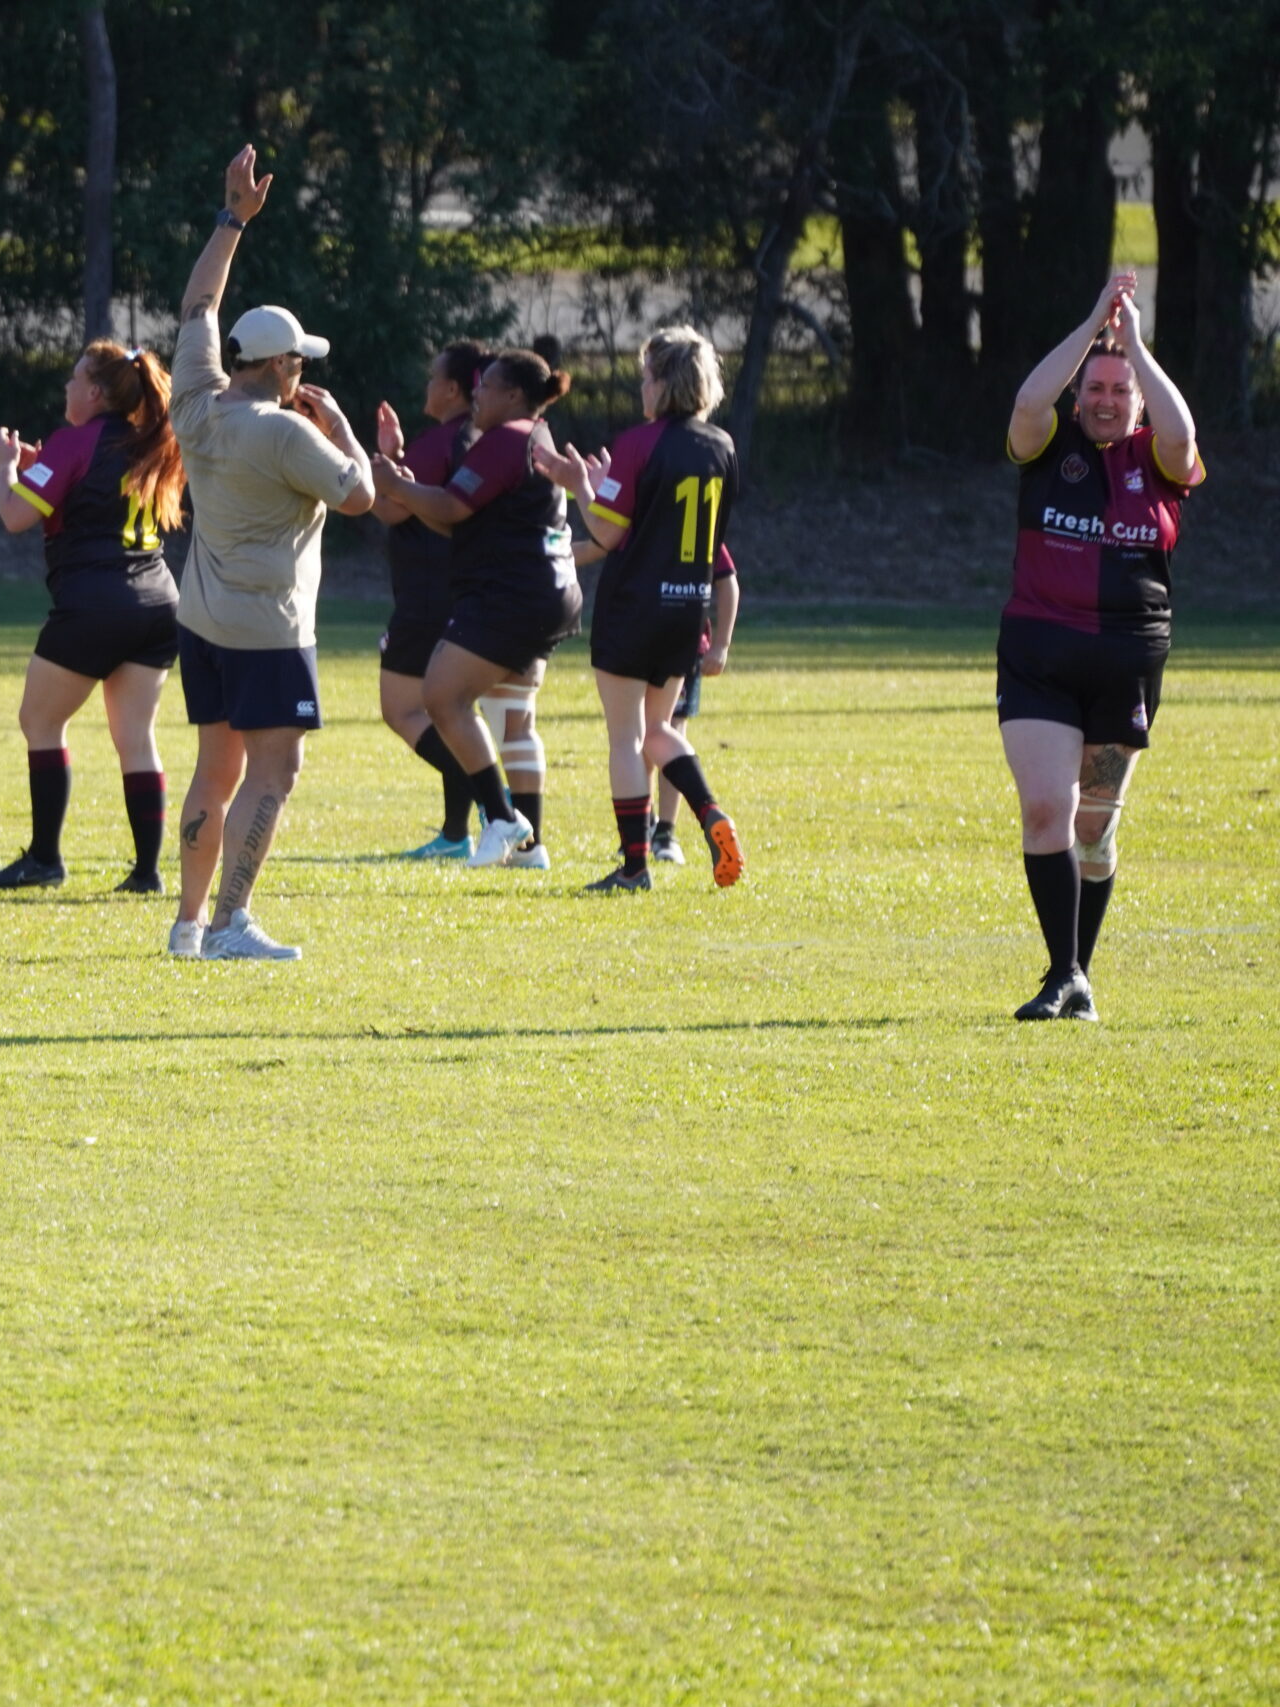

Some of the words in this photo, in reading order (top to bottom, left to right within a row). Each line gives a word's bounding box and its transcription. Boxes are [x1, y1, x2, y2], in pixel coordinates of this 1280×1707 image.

[675, 476, 723, 564] 11
[1043, 506, 1105, 535] Fresh
[1112, 521, 1158, 541] Cuts
[661, 581, 696, 595] Fresh
